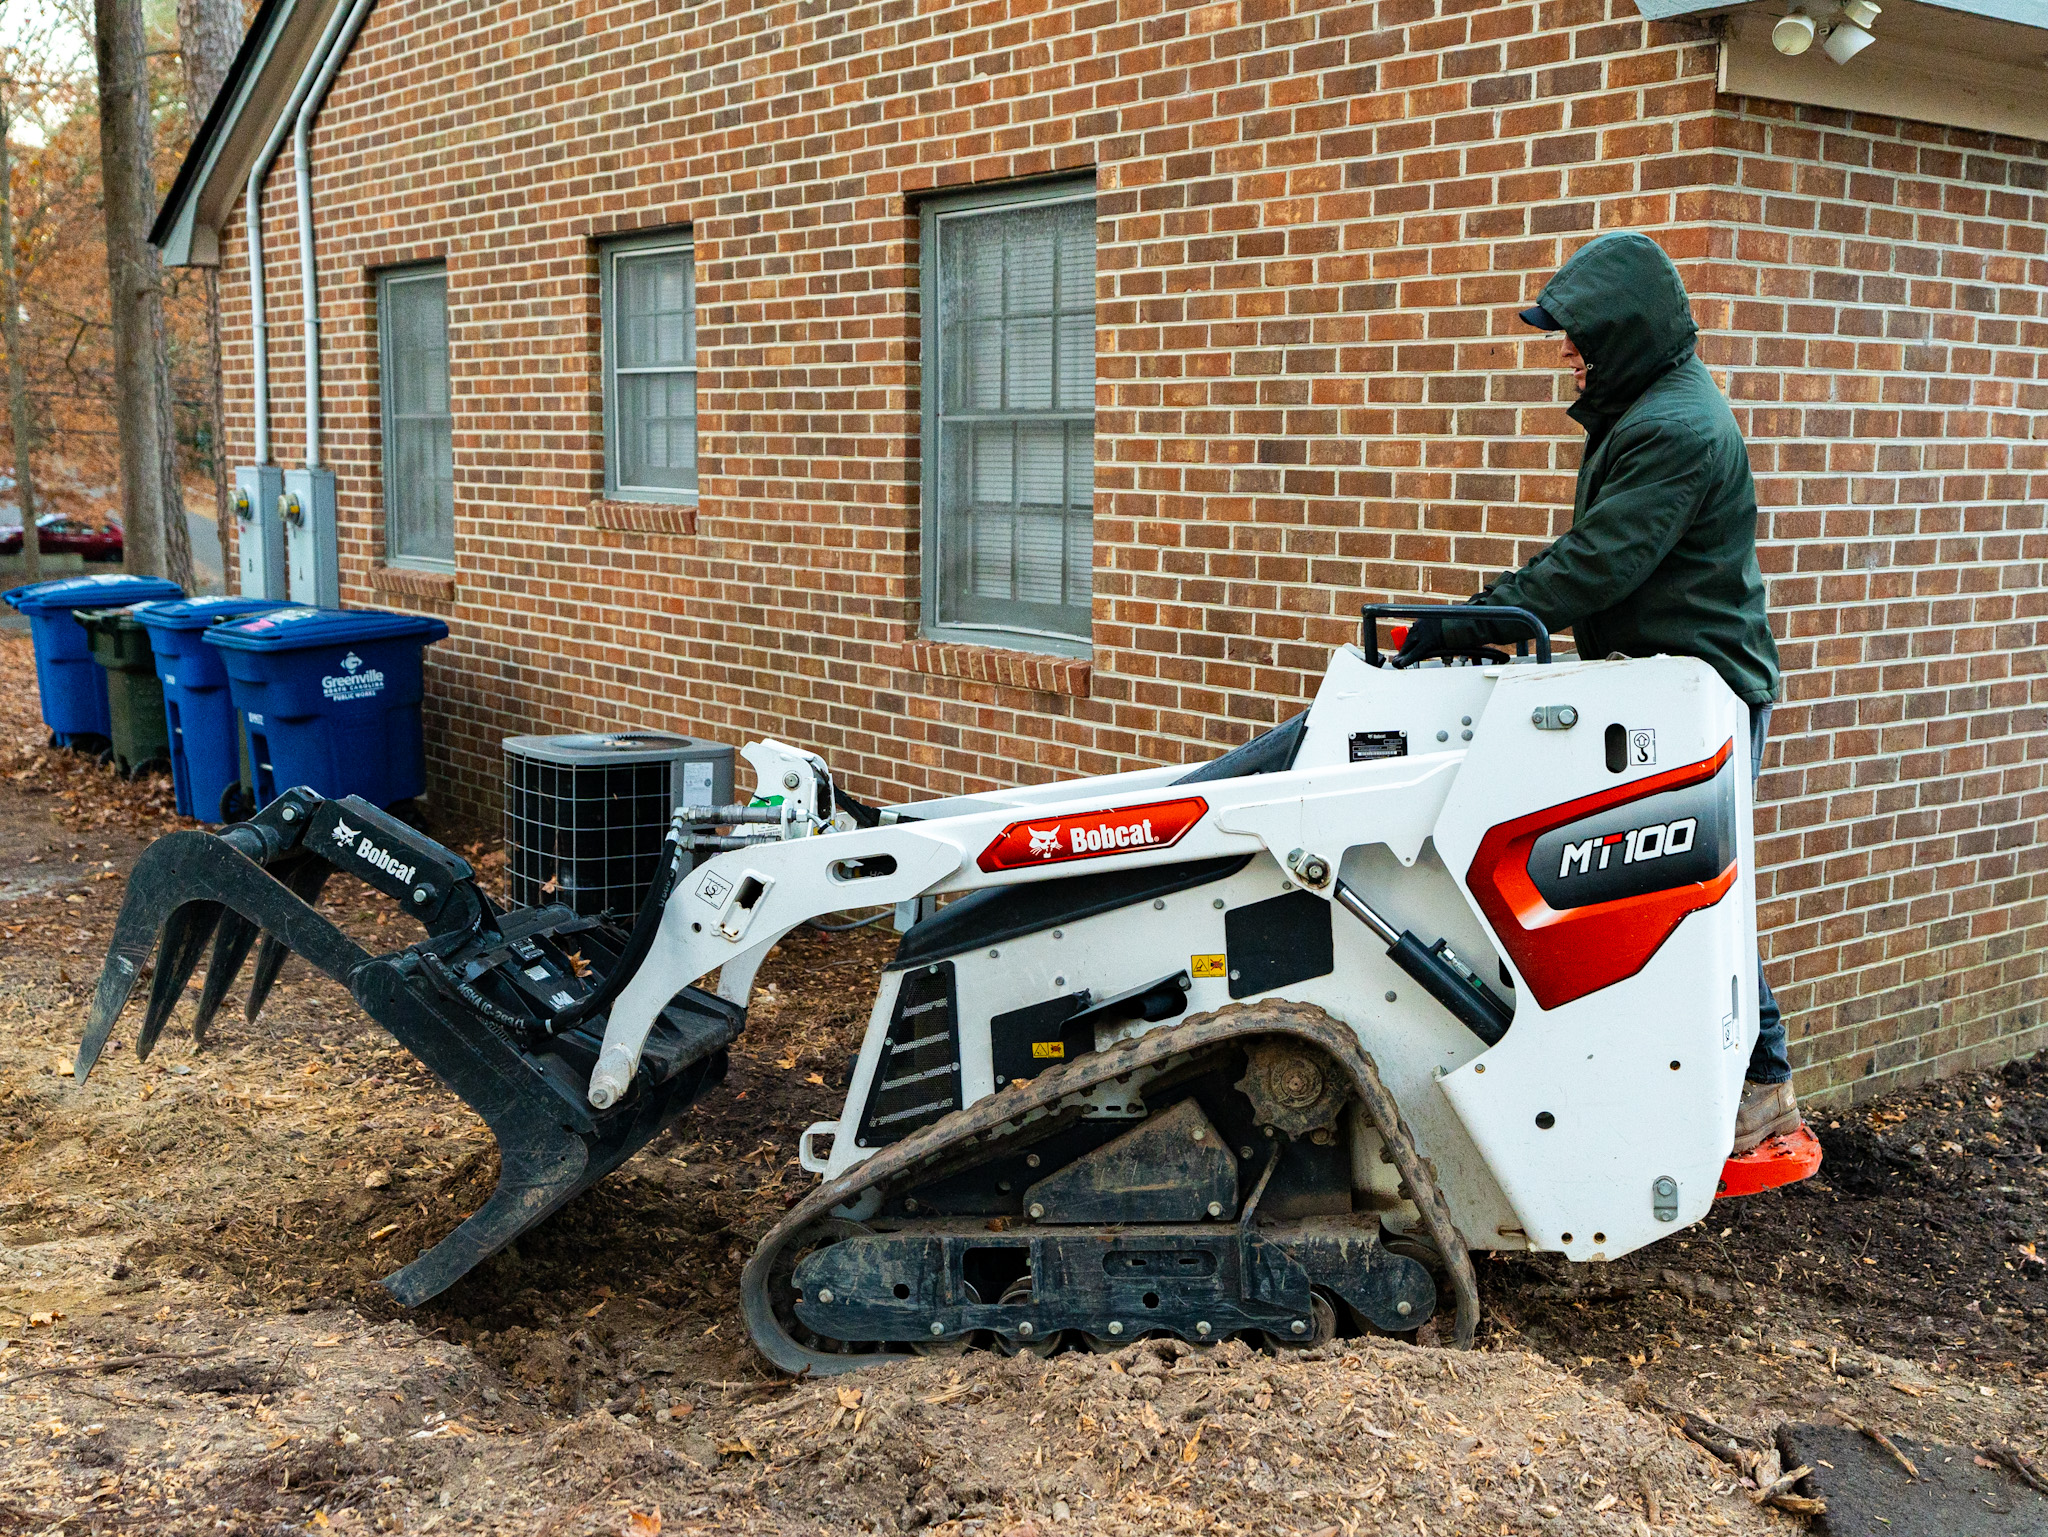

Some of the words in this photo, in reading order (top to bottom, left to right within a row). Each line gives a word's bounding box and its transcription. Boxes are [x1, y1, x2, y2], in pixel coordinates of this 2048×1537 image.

[322, 669, 384, 688] Greenville
[350, 681, 385, 691] CAROLINA
[333, 692, 355, 702] PUBLIC
[355, 690, 377, 699] WORKS
[1070, 819, 1154, 853] Bobcat
[1559, 817, 1697, 878] MT100
[356, 837, 416, 885] Bobcat
